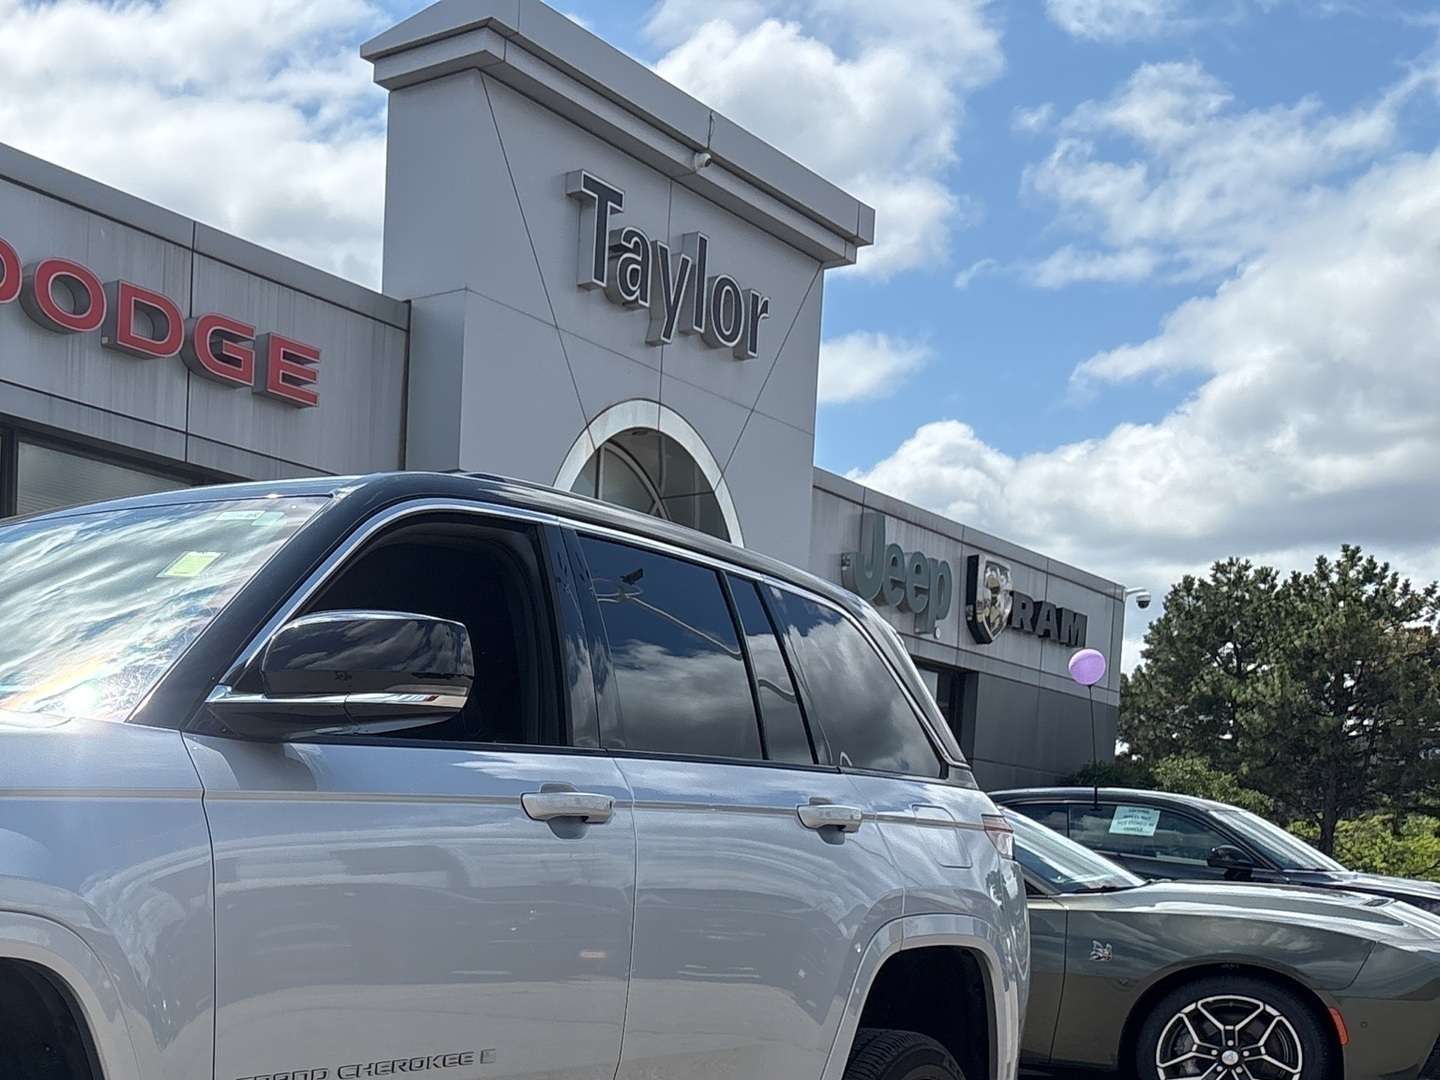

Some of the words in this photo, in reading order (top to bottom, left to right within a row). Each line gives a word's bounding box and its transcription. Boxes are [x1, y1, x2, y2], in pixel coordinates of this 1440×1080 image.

[572, 169, 769, 359] Taylor
[848, 511, 953, 634] Jeep
[1009, 589, 1088, 648] RAM
[336, 1051, 475, 1080] CHEROKEE
